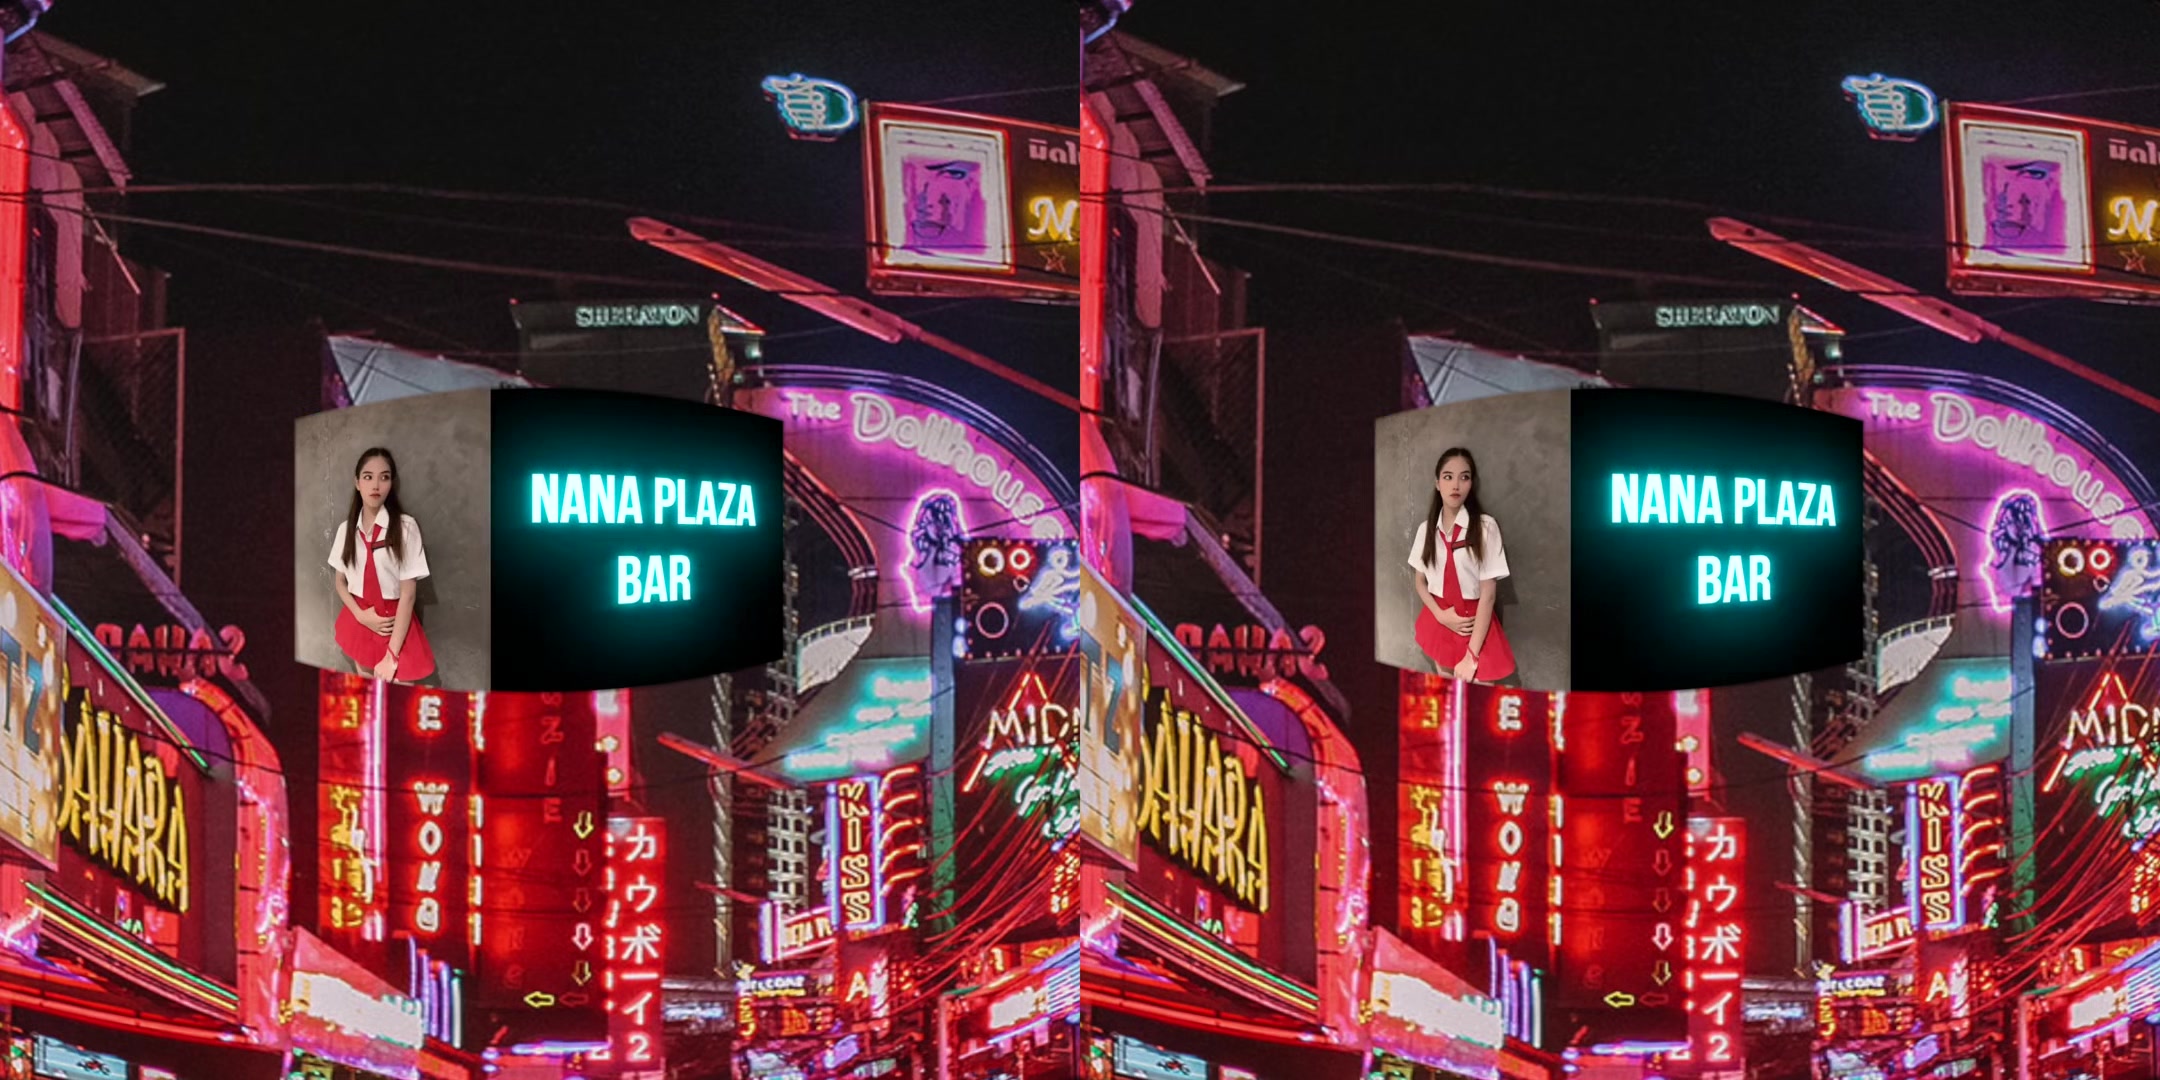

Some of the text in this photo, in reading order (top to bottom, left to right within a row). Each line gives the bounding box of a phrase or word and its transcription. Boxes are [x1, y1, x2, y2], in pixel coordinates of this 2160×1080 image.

[576, 304, 700, 328] SHERATON
[1656, 304, 1780, 328] SHERATON
[785, 391, 841, 420] The
[1865, 391, 1921, 420] The
[838, 781, 871, 925] KISS
[1918, 781, 1951, 925] KISS
